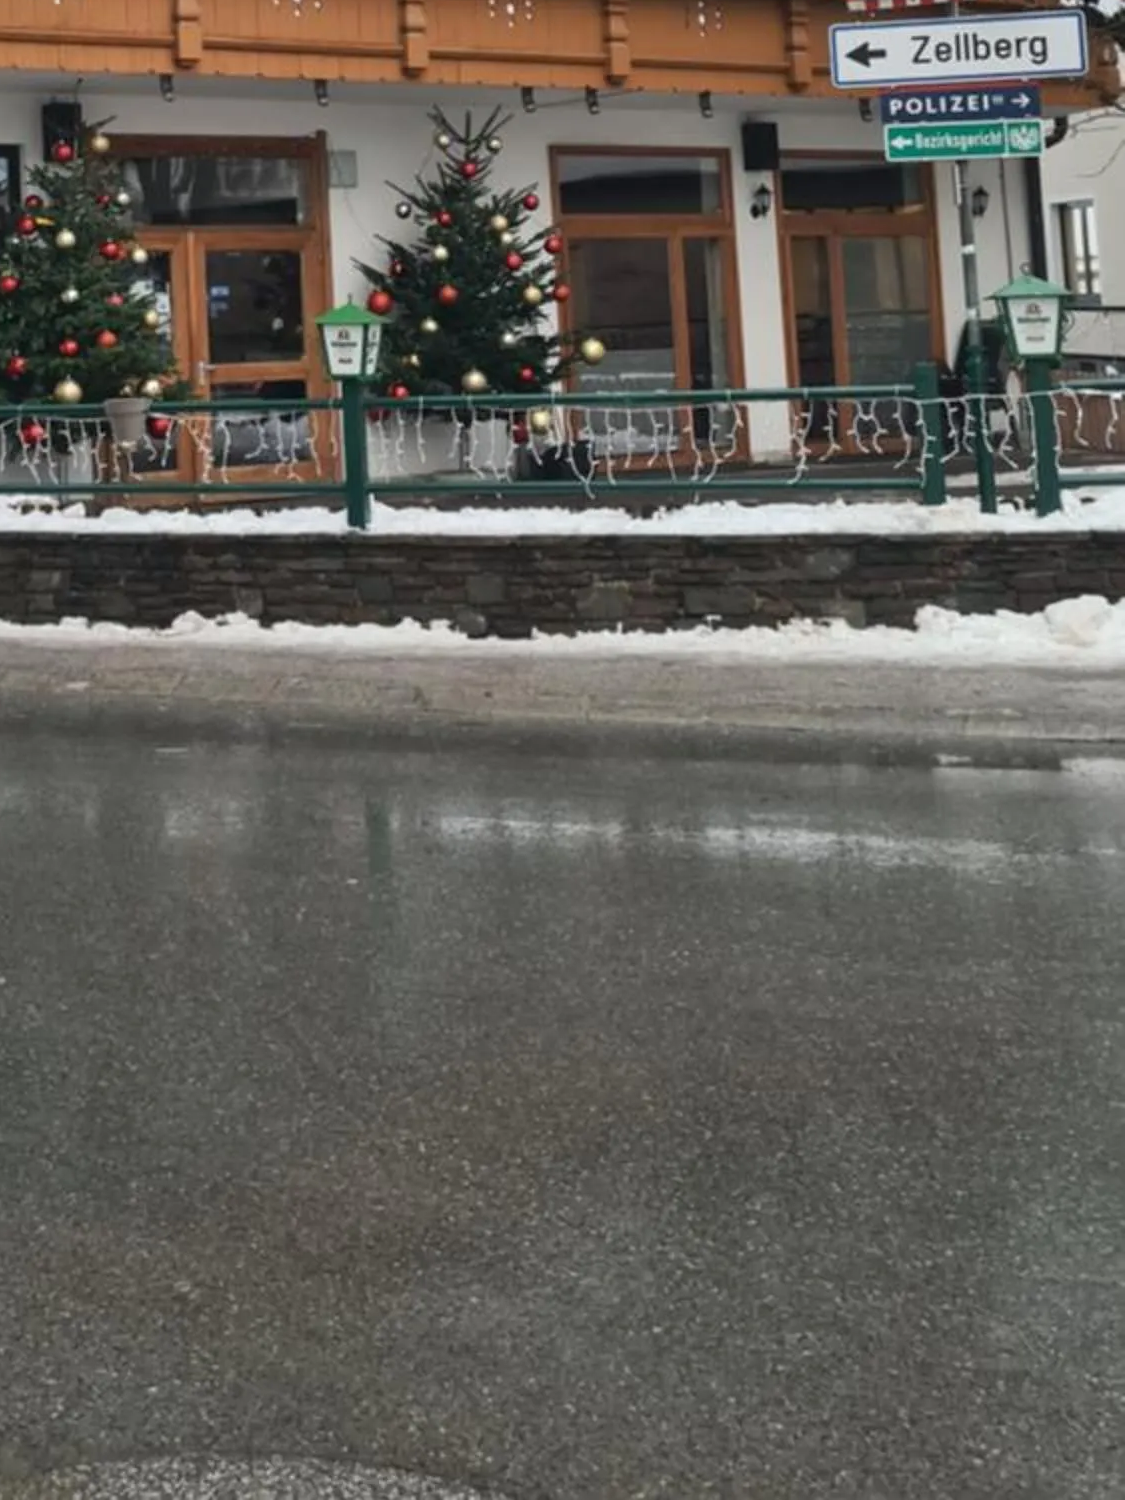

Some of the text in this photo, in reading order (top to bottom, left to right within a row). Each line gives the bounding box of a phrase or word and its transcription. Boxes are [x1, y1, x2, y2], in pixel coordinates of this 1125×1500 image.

[910, 32, 1048, 65] Zellberg
[889, 94, 990, 116] POLIZEI
[914, 129, 1003, 152] Bezirksgericht
